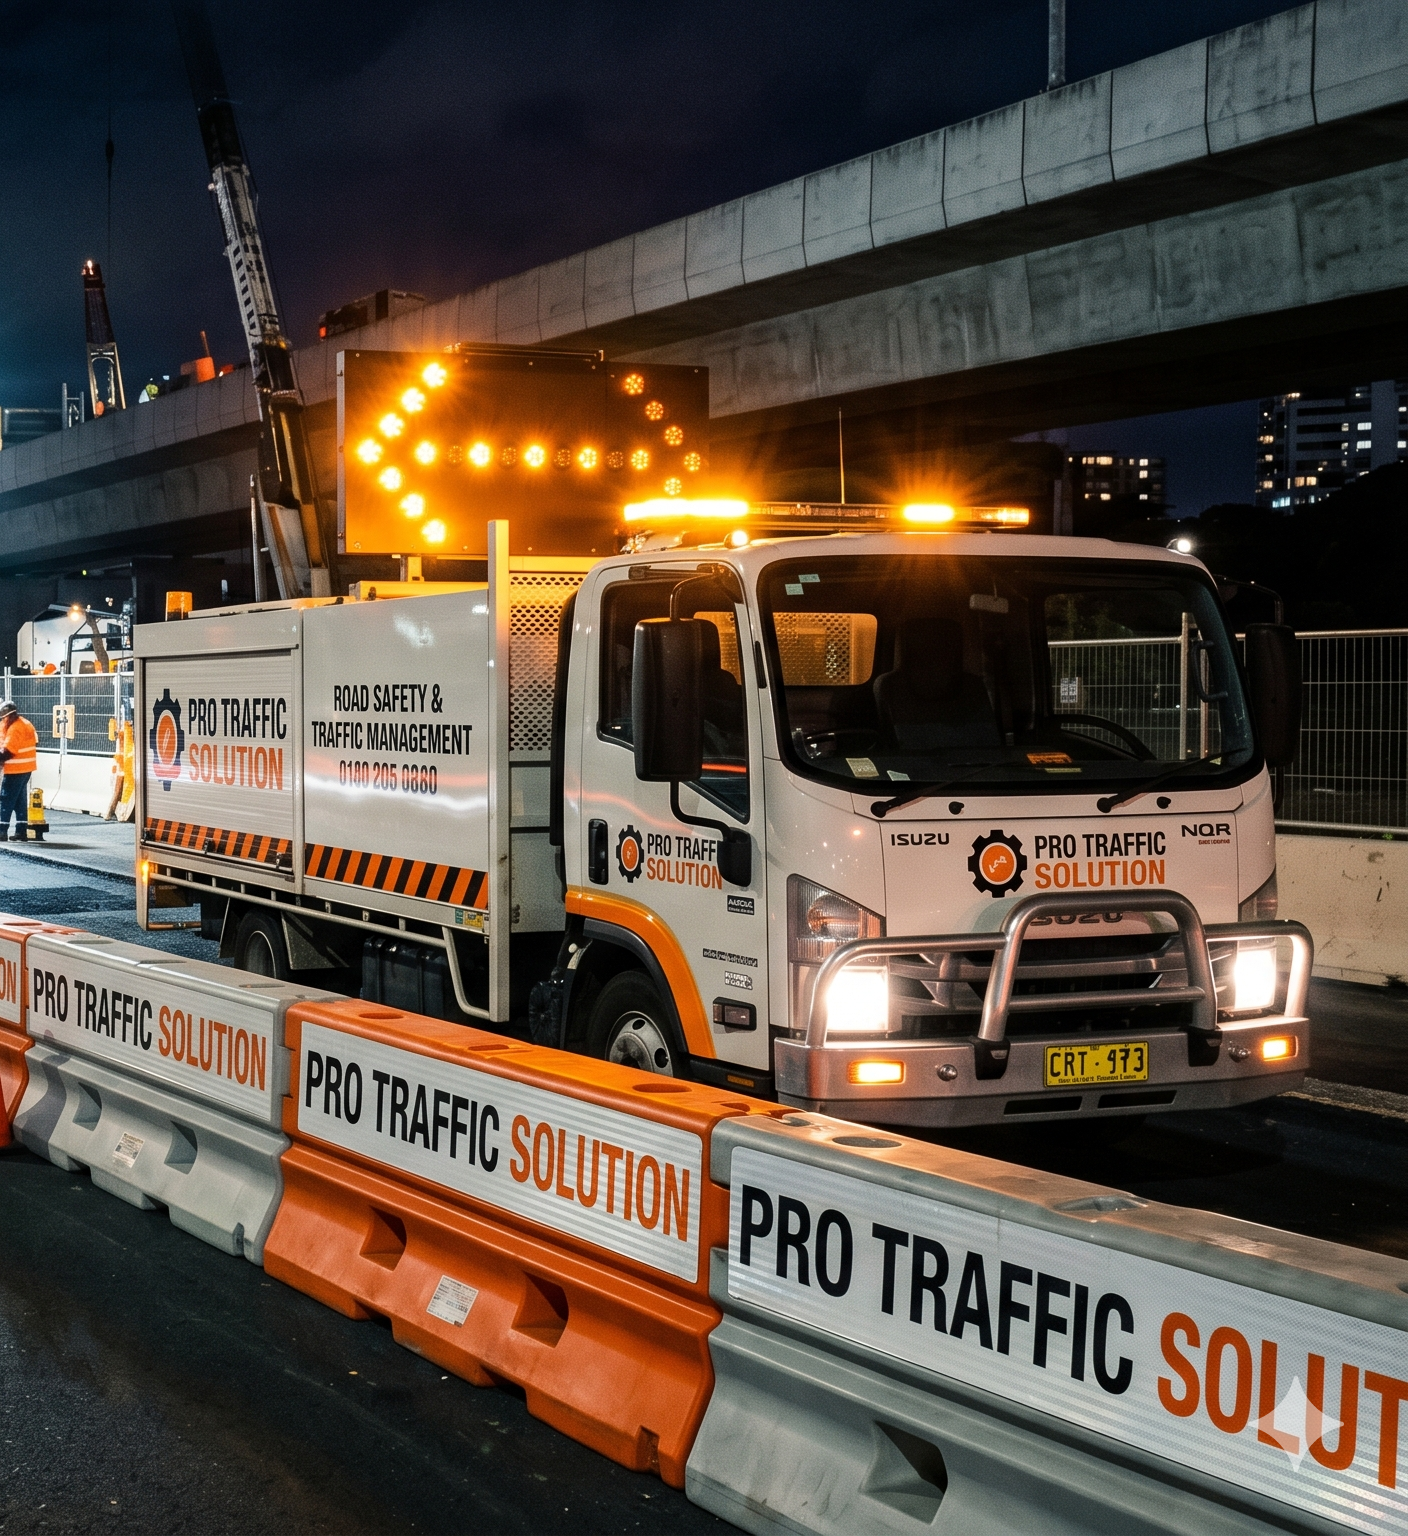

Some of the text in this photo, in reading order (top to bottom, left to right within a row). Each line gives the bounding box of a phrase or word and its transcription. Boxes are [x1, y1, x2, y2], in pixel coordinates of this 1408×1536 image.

[333, 683, 443, 714] ROAD SAFETY &
[188, 697, 287, 740] PRO TRAFFIC
[311, 720, 473, 756] TRAFFIC MANAGEMENT
[188, 743, 284, 791] SOLUTION
[373, 761, 398, 792] 205
[891, 833, 950, 847] ISUZU
[1034, 831, 1167, 860] PRO TRAFFIC
[1181, 823, 1232, 838] NQR
[647, 833, 717, 862] PRO TRAFF
[647, 857, 723, 890] SOLUTION
[1034, 859, 1166, 890] SOLUTION
[33, 968, 267, 1092] PRO TRAFFIC SOLUTION
[1050, 1051, 1088, 1078] CRT
[305, 1050, 690, 1243] PRO TRAFFIC SOLUTION
[739, 1184, 854, 1298] PRO
[871, 1222, 1135, 1396] TRAFFIC
